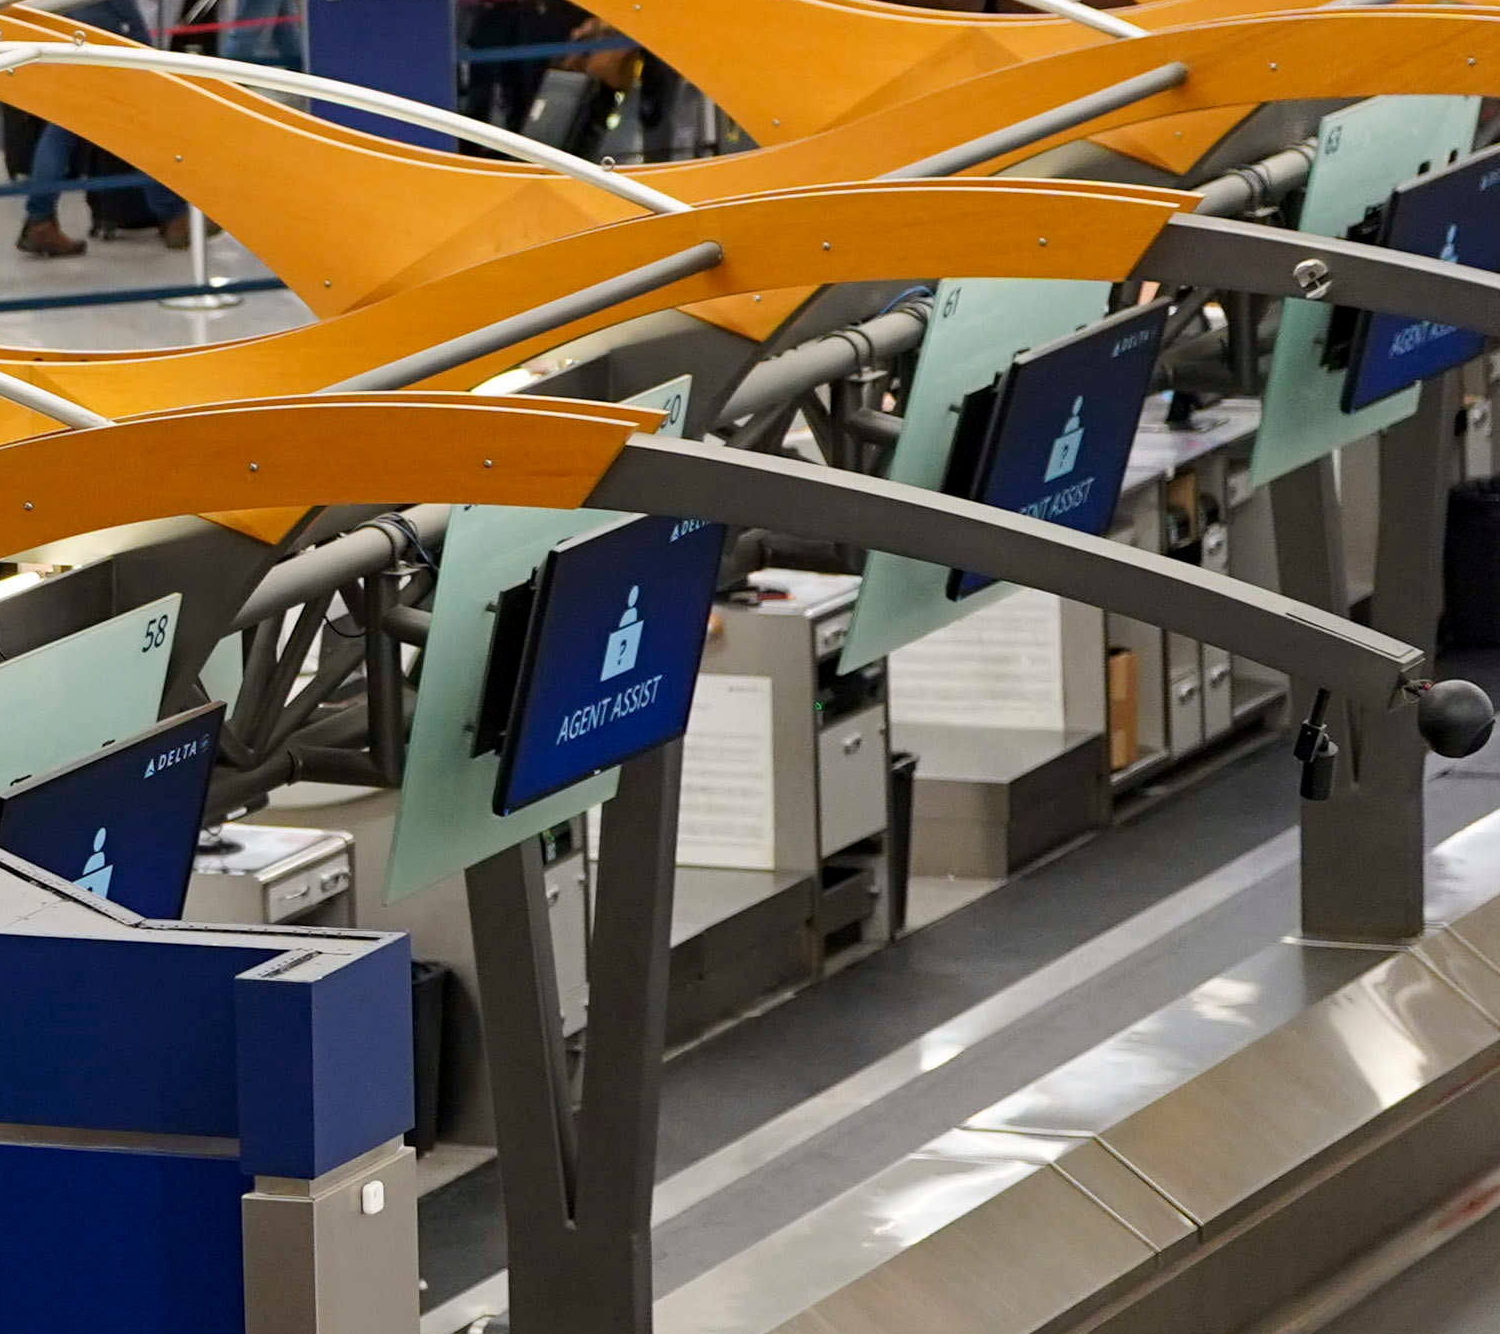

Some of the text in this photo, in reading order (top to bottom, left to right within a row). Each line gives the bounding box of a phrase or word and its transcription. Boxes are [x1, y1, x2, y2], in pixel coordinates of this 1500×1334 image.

[943, 286, 963, 319] 61
[1049, 476, 1096, 519] ASSIST
[141, 613, 169, 653] 58
[556, 673, 664, 746] AGENT ASSIST
[156, 739, 198, 772] DELTA
